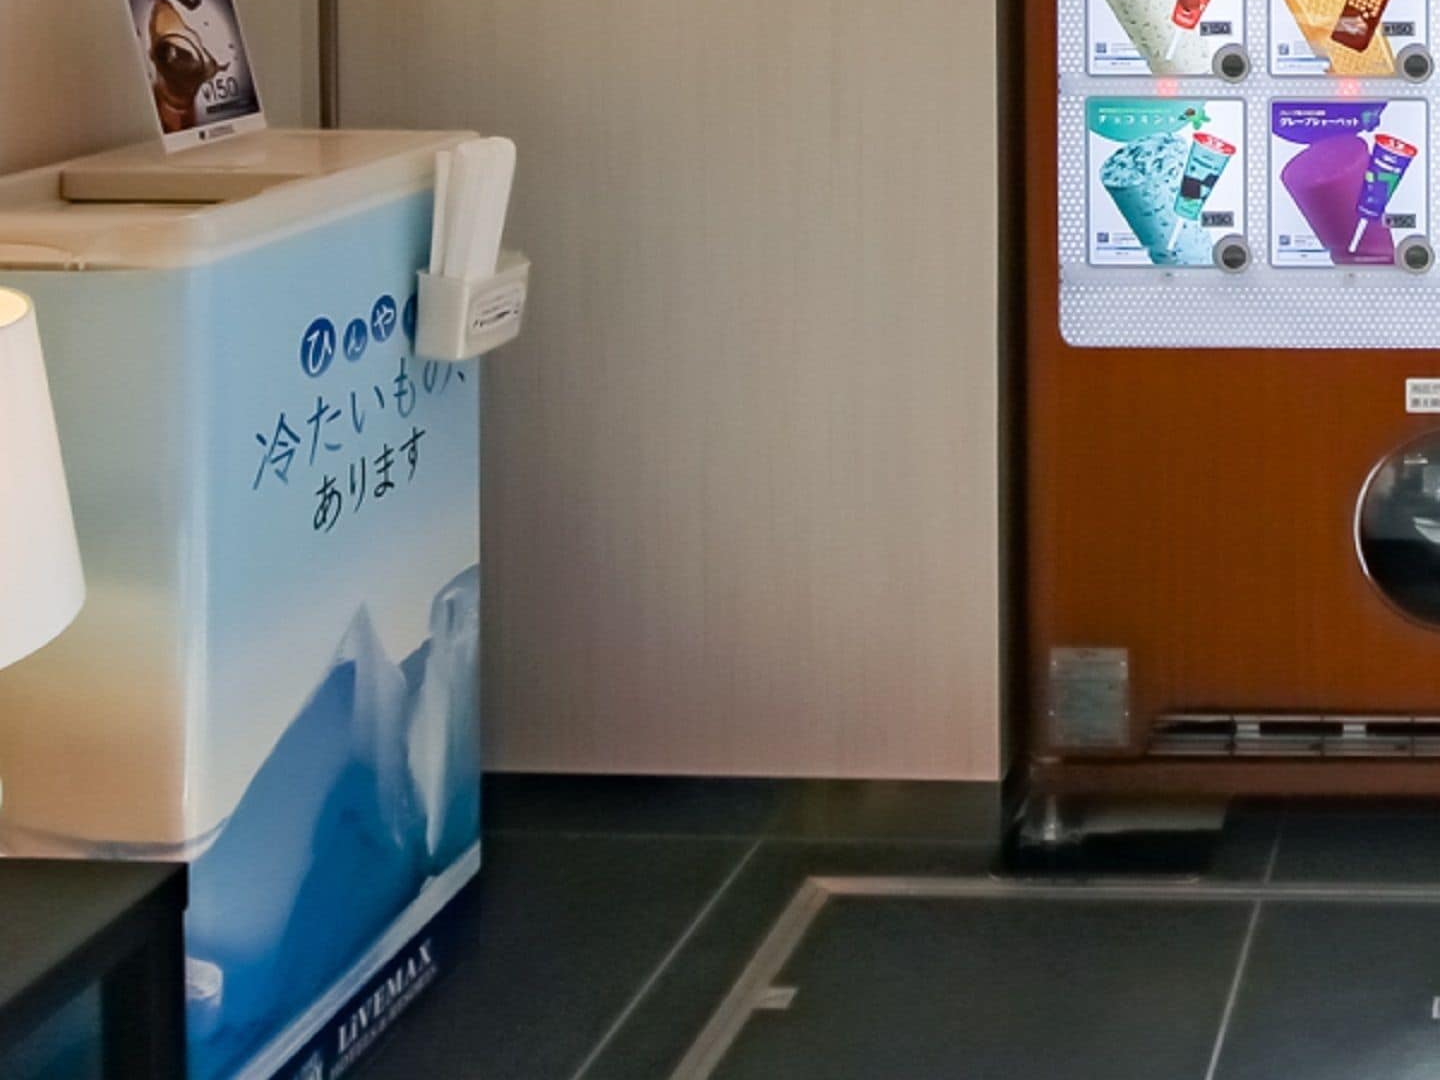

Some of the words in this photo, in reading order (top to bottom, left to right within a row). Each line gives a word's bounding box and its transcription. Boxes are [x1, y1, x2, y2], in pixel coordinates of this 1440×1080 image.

[302, 294, 417, 378] ひんや
[313, 427, 427, 534] あります
